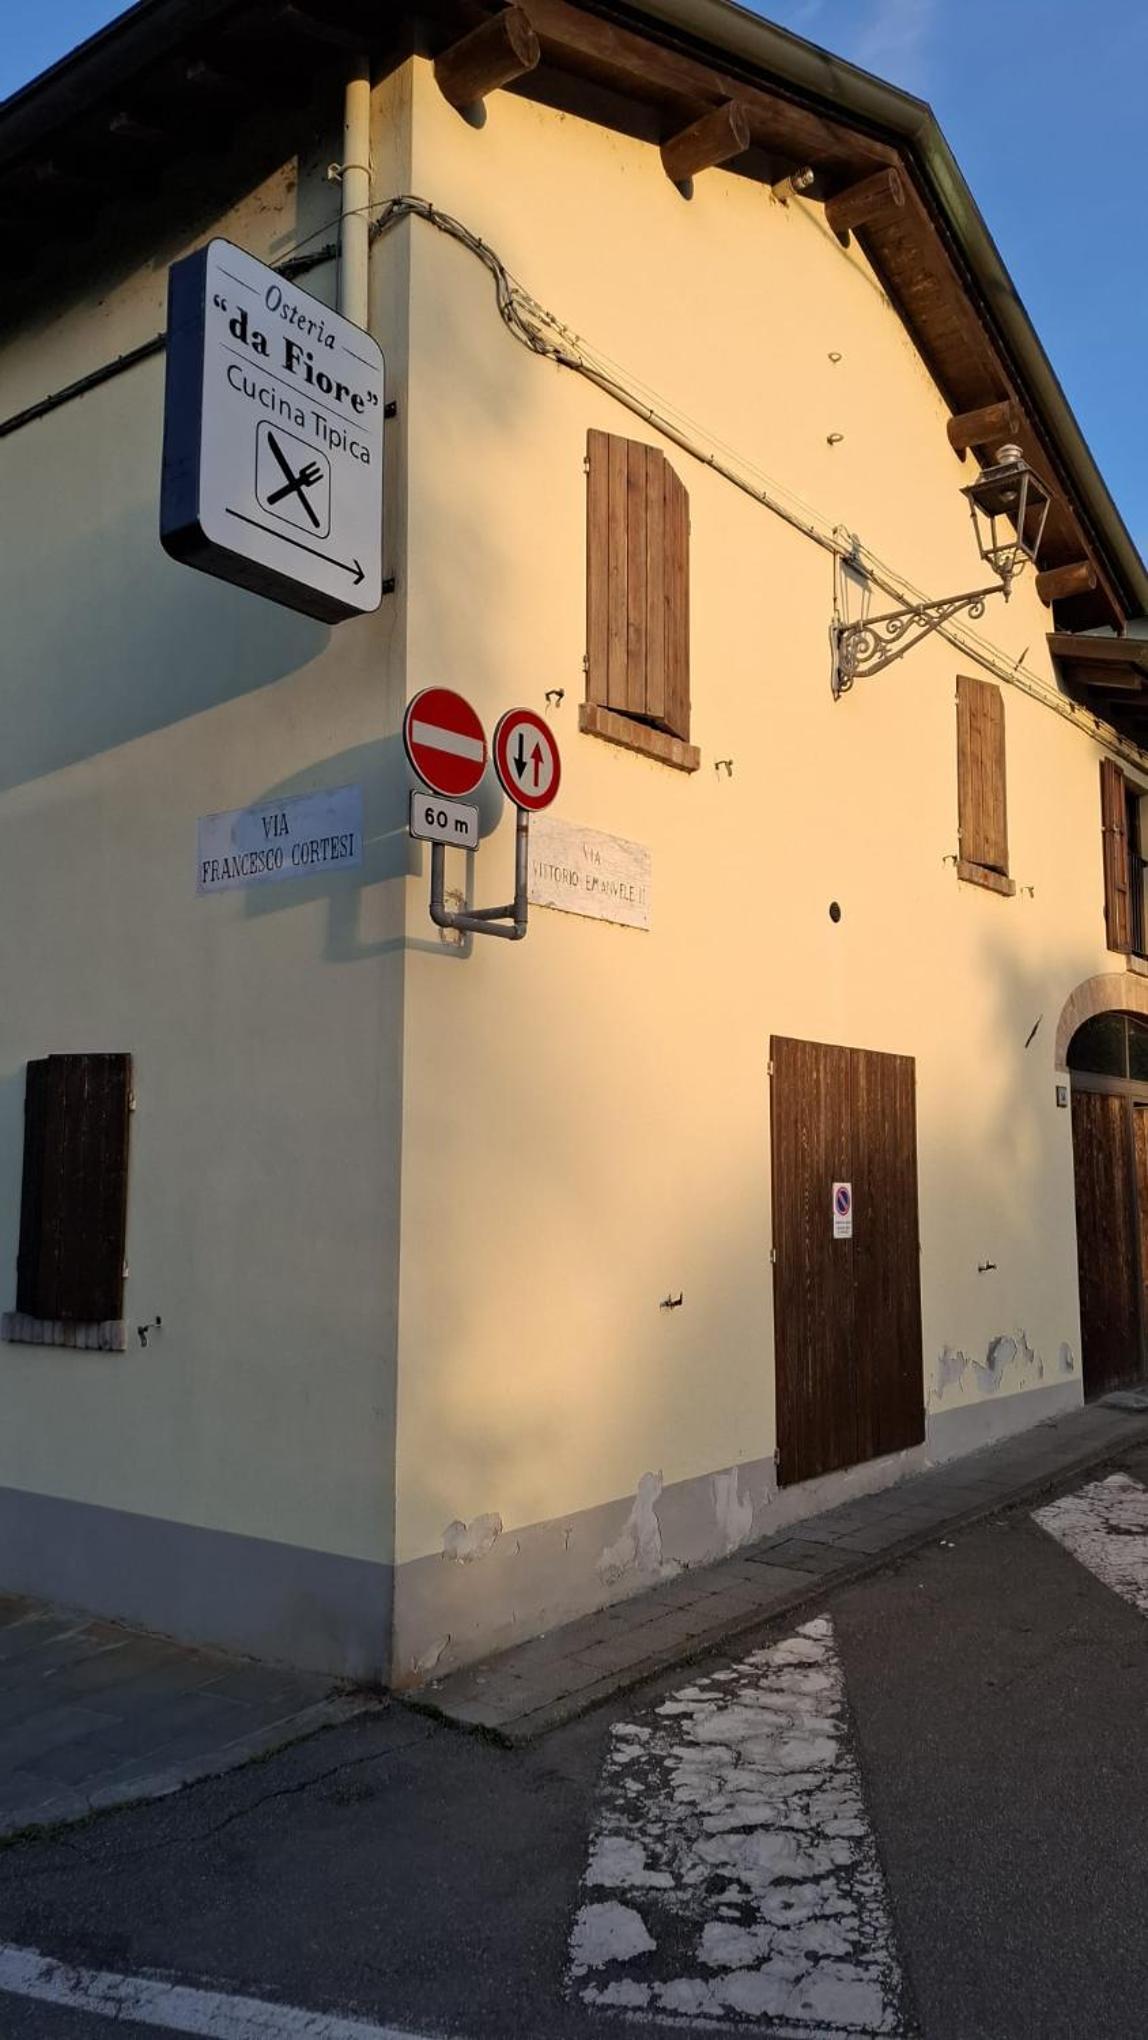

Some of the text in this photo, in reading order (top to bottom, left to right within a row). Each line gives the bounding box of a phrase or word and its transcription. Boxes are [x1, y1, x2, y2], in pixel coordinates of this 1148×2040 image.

[264, 285, 336, 350] Osteria
[227, 364, 371, 465] Cucina Tipica
[261, 813, 290, 838] VIA
[425, 807, 469, 834] 60 m
[202, 833, 354, 883] FRANCESCO CORTESI
[582, 842, 601, 865] VIA
[533, 860, 578, 888] VITTORIO
